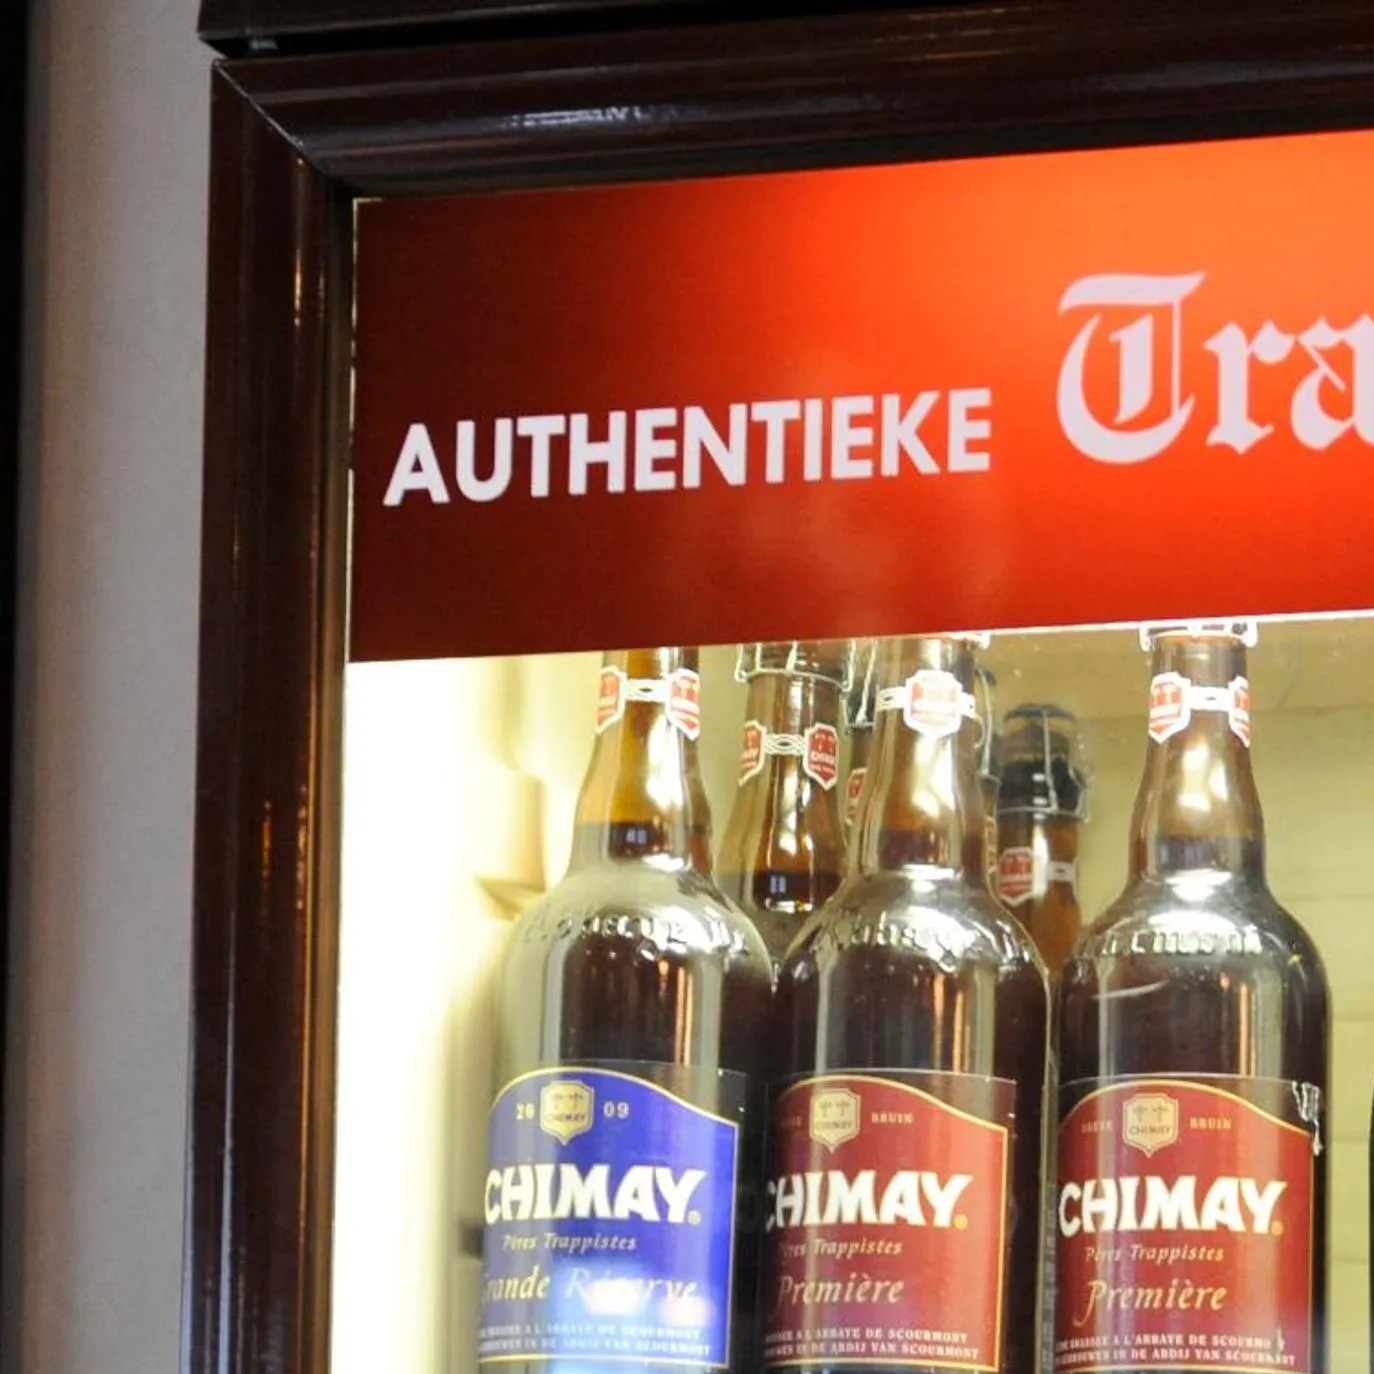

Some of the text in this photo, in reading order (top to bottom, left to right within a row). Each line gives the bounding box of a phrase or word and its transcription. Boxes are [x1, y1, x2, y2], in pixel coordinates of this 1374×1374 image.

[384, 387, 991, 507] AUTHENTIEKE
[603, 1101, 630, 1119] 09
[871, 1111, 914, 1125] BRUIN
[1190, 1116, 1232, 1130] BRUIN
[484, 1163, 707, 1225] CHIMAY
[1058, 1175, 1288, 1237] CHIMAY
[543, 1232, 638, 1254] Trappistes
[813, 1236, 904, 1259] Trappistes
[1130, 1243, 1226, 1265] Trappistes
[777, 1271, 905, 1308] Première
[1072, 1276, 1228, 1328] Première
[865, 1327, 883, 1341] DE
[887, 1328, 969, 1344] SCOURMONT
[1188, 1333, 1207, 1347] DE
[1212, 1334, 1286, 1351] SCOURMOT
[871, 1341, 897, 1354] VAN
[1195, 1348, 1221, 1361] VAN
